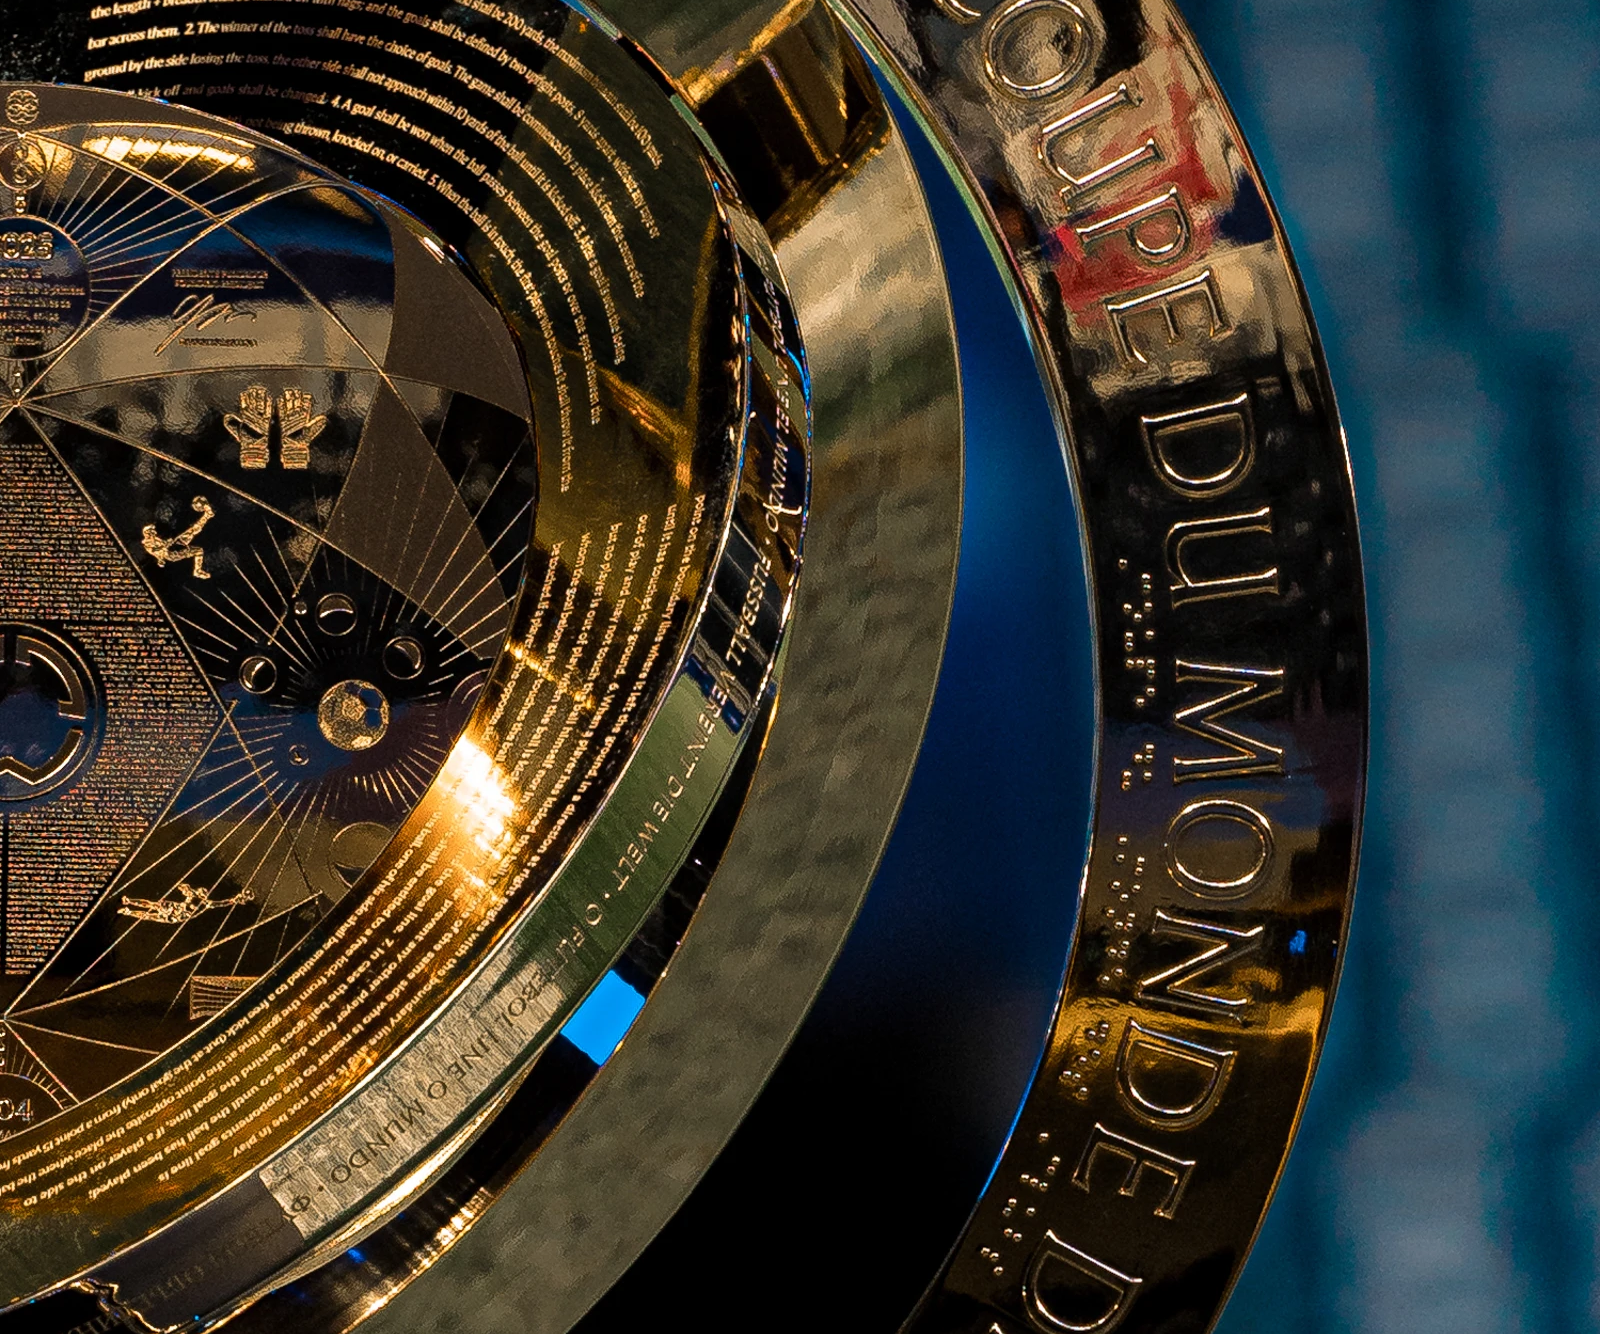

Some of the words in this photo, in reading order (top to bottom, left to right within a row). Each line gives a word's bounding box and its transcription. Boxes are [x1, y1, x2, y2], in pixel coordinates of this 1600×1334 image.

[89, 4, 111, 19] the
[490, 5, 505, 21] be
[501, 10, 525, 31] 200
[690, 493, 706, 526] point
[1141, 392, 1280, 610] DU
[686, 526, 699, 544] on
[680, 543, 696, 566] the
[661, 565, 688, 620] boundary
[726, 547, 776, 666] FUSSBALL
[653, 620, 672, 642] line
[637, 642, 660, 679] where
[631, 680, 646, 690] it
[621, 691, 641, 712] left
[610, 711, 629, 736] the
[673, 667, 739, 780] VEREINT
[570, 793, 581, 802] a
[576, 780, 591, 793] in
[649, 774, 688, 823] DIE
[535, 802, 575, 854] direction
[525, 854, 541, 868] at
[606, 819, 662, 892] WELT
[504, 867, 530, 897] right
[476, 896, 509, 934] angles
[580, 901, 607, 928] O
[453, 931, 480, 957] with
[1071, 658, 1285, 1219] MONDE
[435, 956, 457, 979] the
[491, 924, 589, 1036] FUTEBOL
[386, 974, 440, 1028] boundary
[367, 1024, 392, 1046] line
[334, 1063, 348, 1077] it
[443, 1028, 500, 1087] UNE
[307, 1072, 338, 1100] shall
[424, 1077, 452, 1105] O
[284, 1094, 309, 1116] not
[254, 1122, 272, 1138] in
[267, 1111, 289, 1128] be
[232, 1132, 259, 1158] play
[327, 1097, 430, 1189] MUNDO
